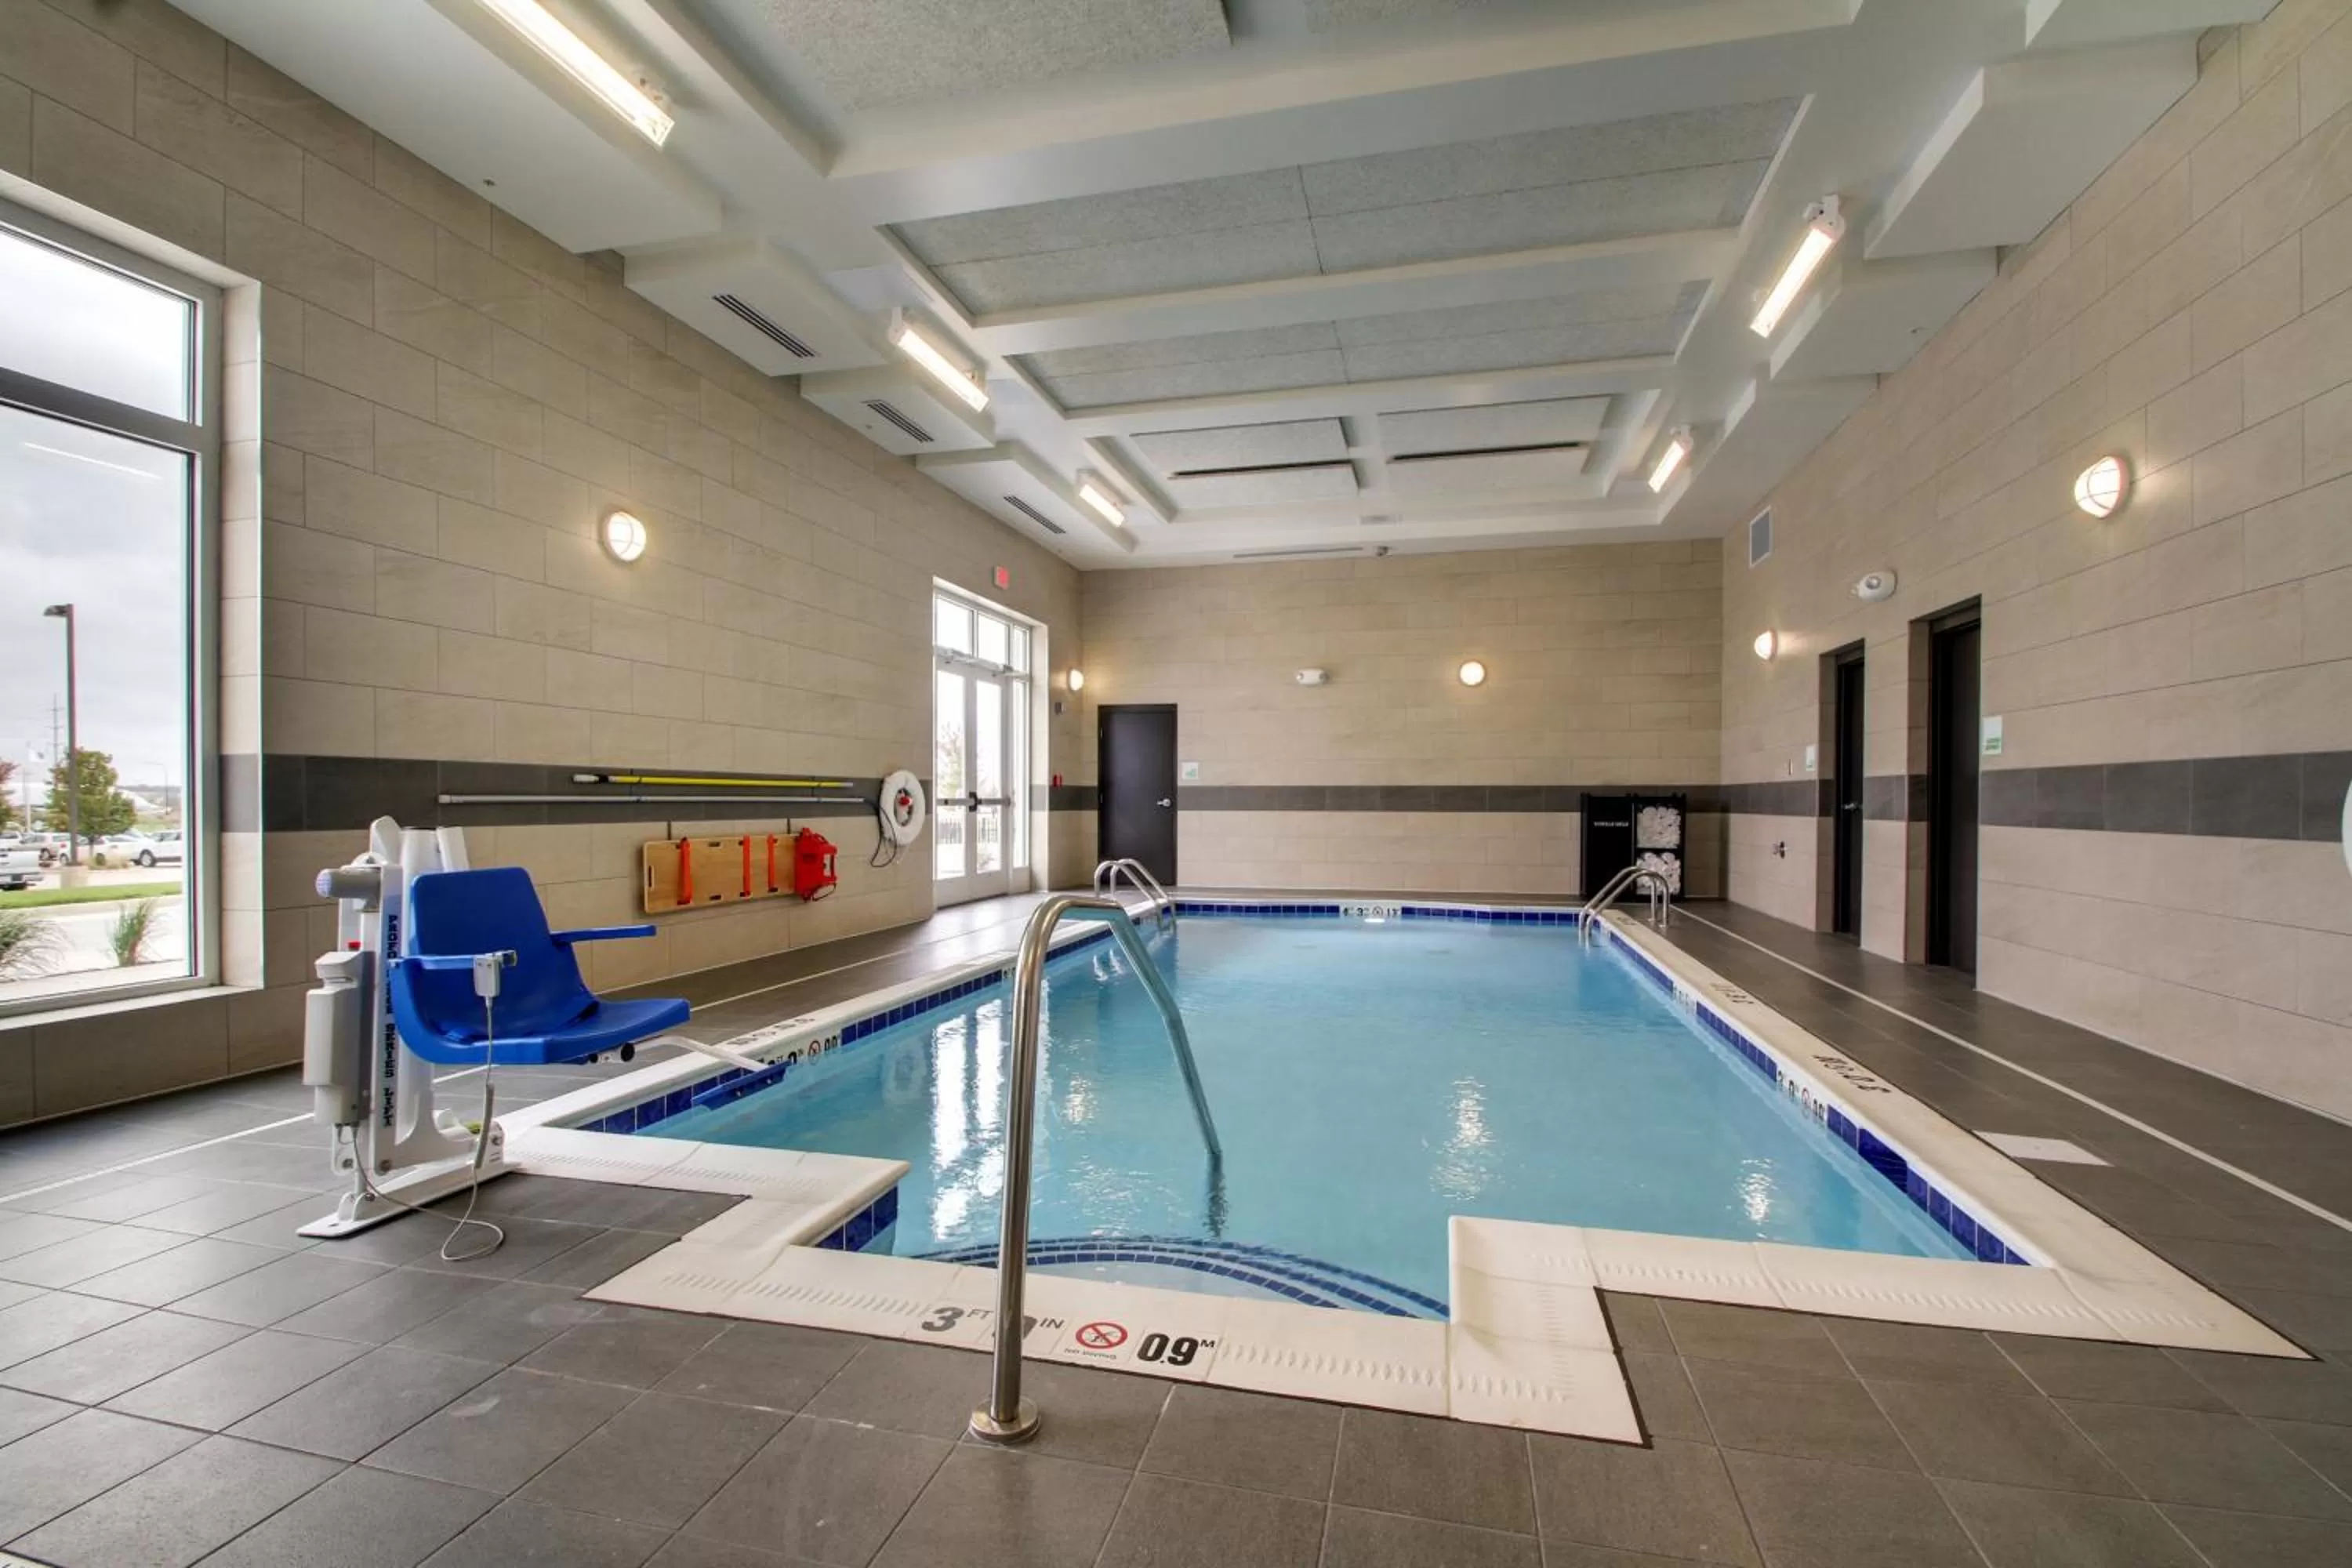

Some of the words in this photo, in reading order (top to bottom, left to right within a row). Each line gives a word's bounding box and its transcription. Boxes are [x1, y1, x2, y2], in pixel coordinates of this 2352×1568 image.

[385, 1023, 396, 1078] SERIES
[921, 1306, 965, 1332] 3
[967, 1308, 994, 1320] FT
[1040, 1317, 1065, 1329] IN
